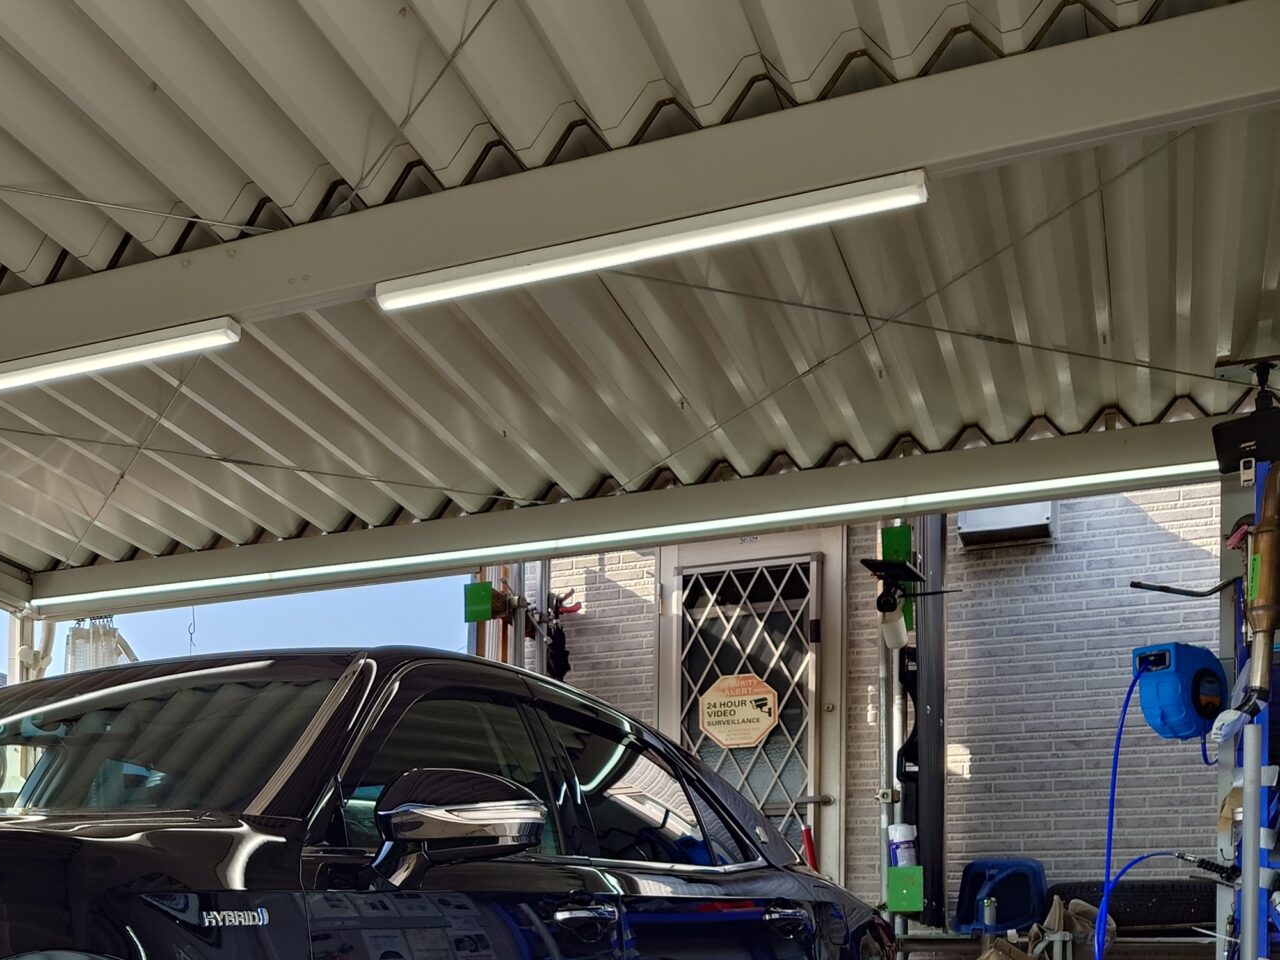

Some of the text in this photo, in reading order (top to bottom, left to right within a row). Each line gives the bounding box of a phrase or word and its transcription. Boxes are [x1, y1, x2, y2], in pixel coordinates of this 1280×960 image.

[720, 680, 757, 688] URITY
[724, 687, 752, 696] ALERT
[707, 700, 747, 710] 24 HOUR
[707, 709, 736, 718] VIDEO
[707, 717, 760, 726] SURVEILLANCE
[203, 911, 259, 927] HYBRID
